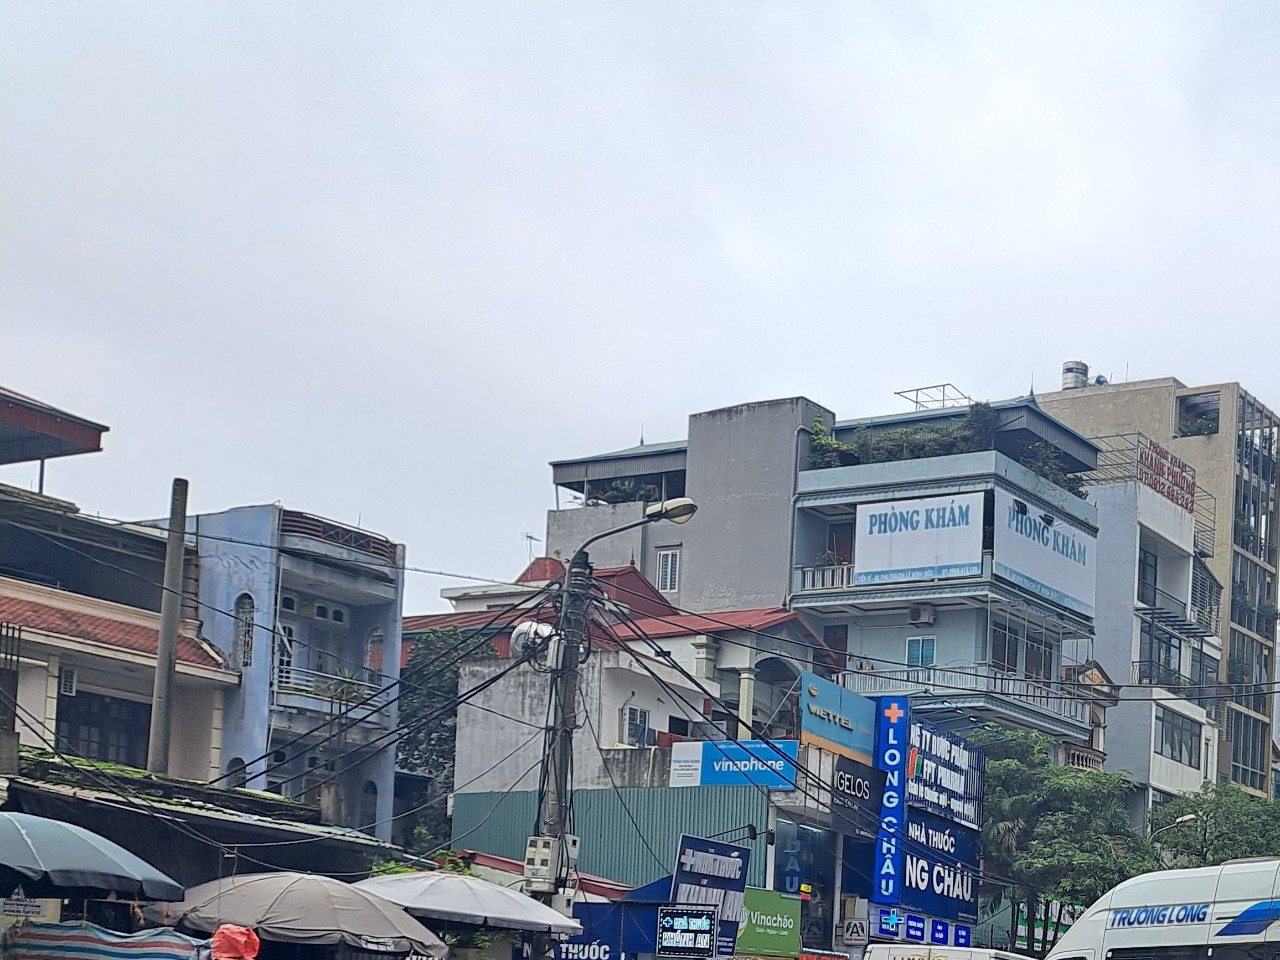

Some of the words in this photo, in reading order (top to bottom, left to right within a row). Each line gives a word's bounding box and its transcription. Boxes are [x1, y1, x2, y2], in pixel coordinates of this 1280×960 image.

[868, 506, 920, 535] PHÒNG
[924, 502, 970, 529] KHÁM
[1053, 528, 1087, 567] KHÁM
[807, 702, 853, 732] VIETTEL
[713, 757, 785, 773] vinaphone
[882, 728, 901, 808] LONG
[908, 822, 926, 845] NHÀ
[928, 829, 955, 853] THUỐC
[880, 816, 899, 896] CHÂU
[932, 862, 972, 903] CHÂU
[751, 910, 794, 929] Vinacháo
[1167, 904, 1210, 924] LONG
[559, 939, 611, 960] THUỐC
[661, 930, 695, 948] KHÁNH
[695, 933, 710, 948] AN
